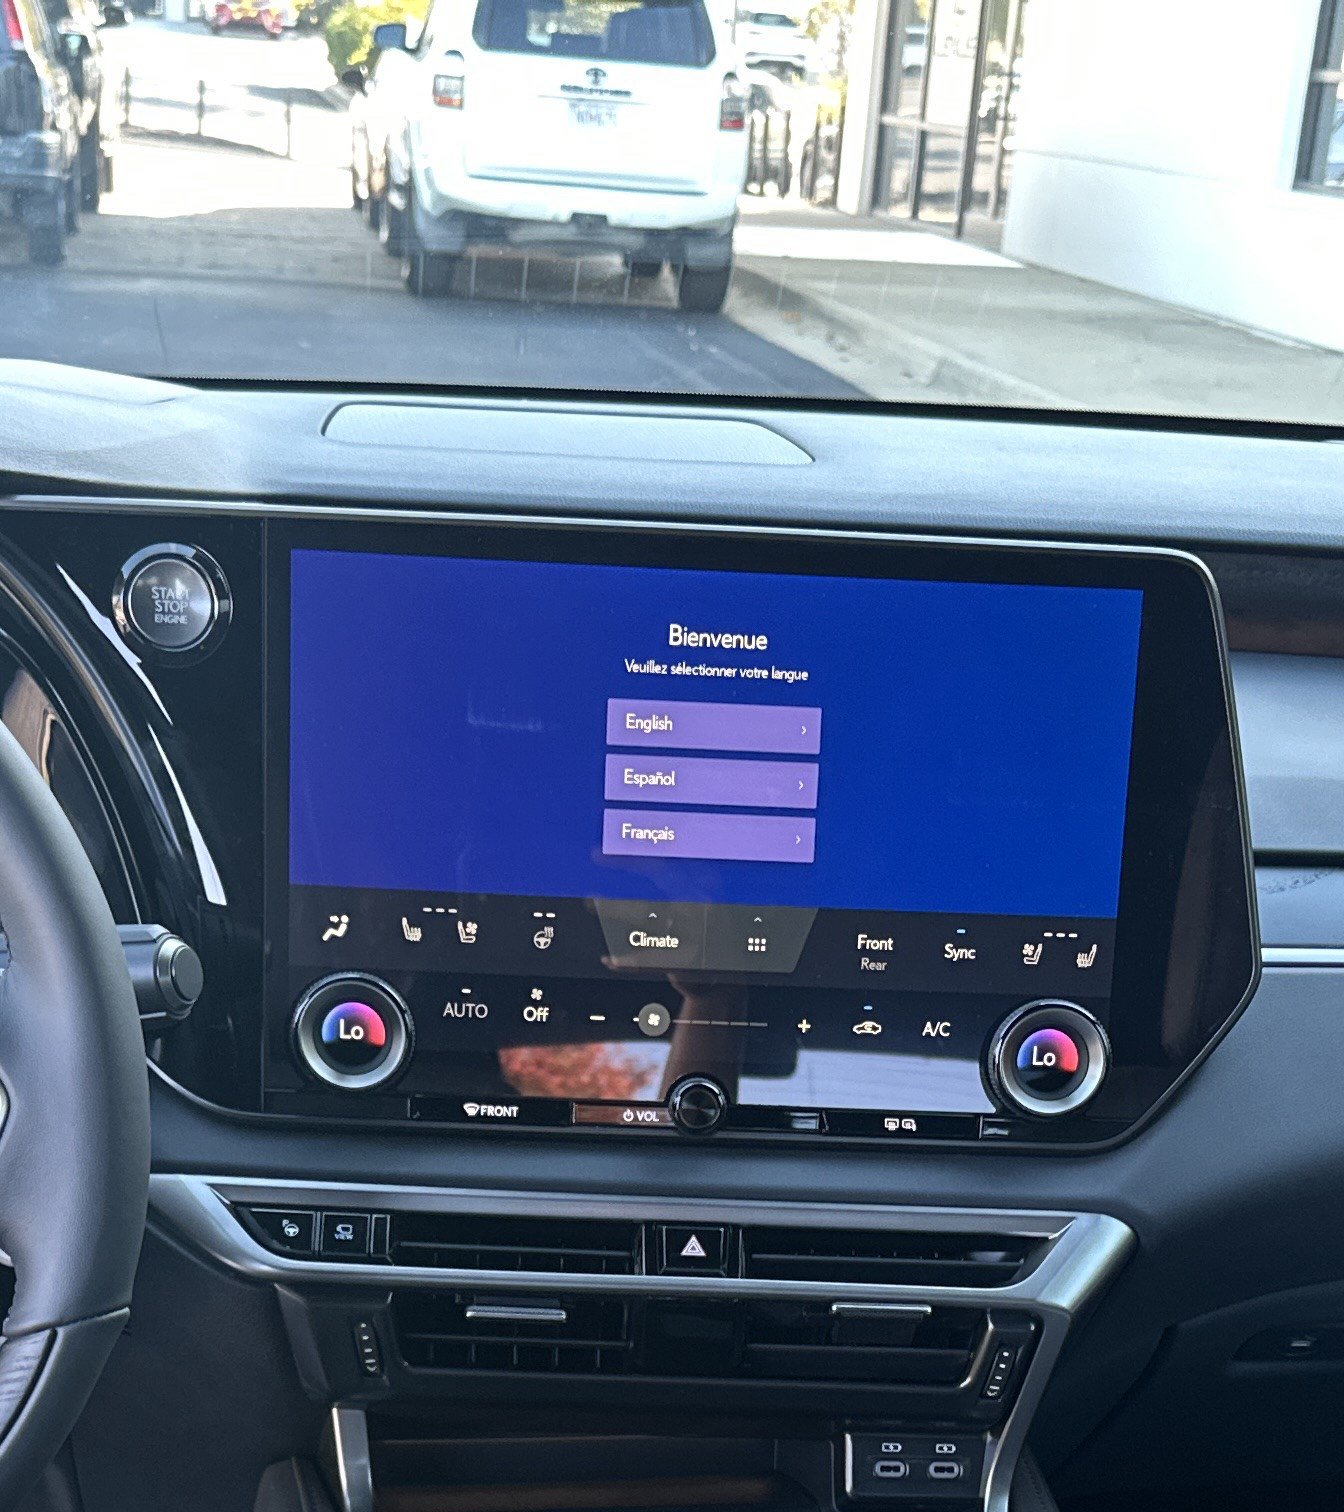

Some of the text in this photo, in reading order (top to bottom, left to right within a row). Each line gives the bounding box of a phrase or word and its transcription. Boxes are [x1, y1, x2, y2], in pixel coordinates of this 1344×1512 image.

[154, 600, 189, 614] STOP
[154, 613, 189, 626] ENGINE
[667, 623, 769, 651] Bienvenue
[624, 658, 809, 684] Veuillez sélectionner votre langue
[625, 712, 674, 735] English
[623, 767, 676, 788] Español
[621, 822, 675, 845] Français
[628, 931, 680, 949] Climate
[856, 933, 894, 952] Front
[943, 943, 977, 963] Sync
[860, 957, 888, 972] Rear
[443, 1002, 489, 1020] AUTO
[522, 1005, 550, 1023] Off
[338, 1017, 365, 1042] Lo
[921, 1020, 952, 1038] A/C
[1031, 1044, 1057, 1068] Lo
[479, 1104, 520, 1118] FRONT
[636, 1110, 660, 1123] VOL
